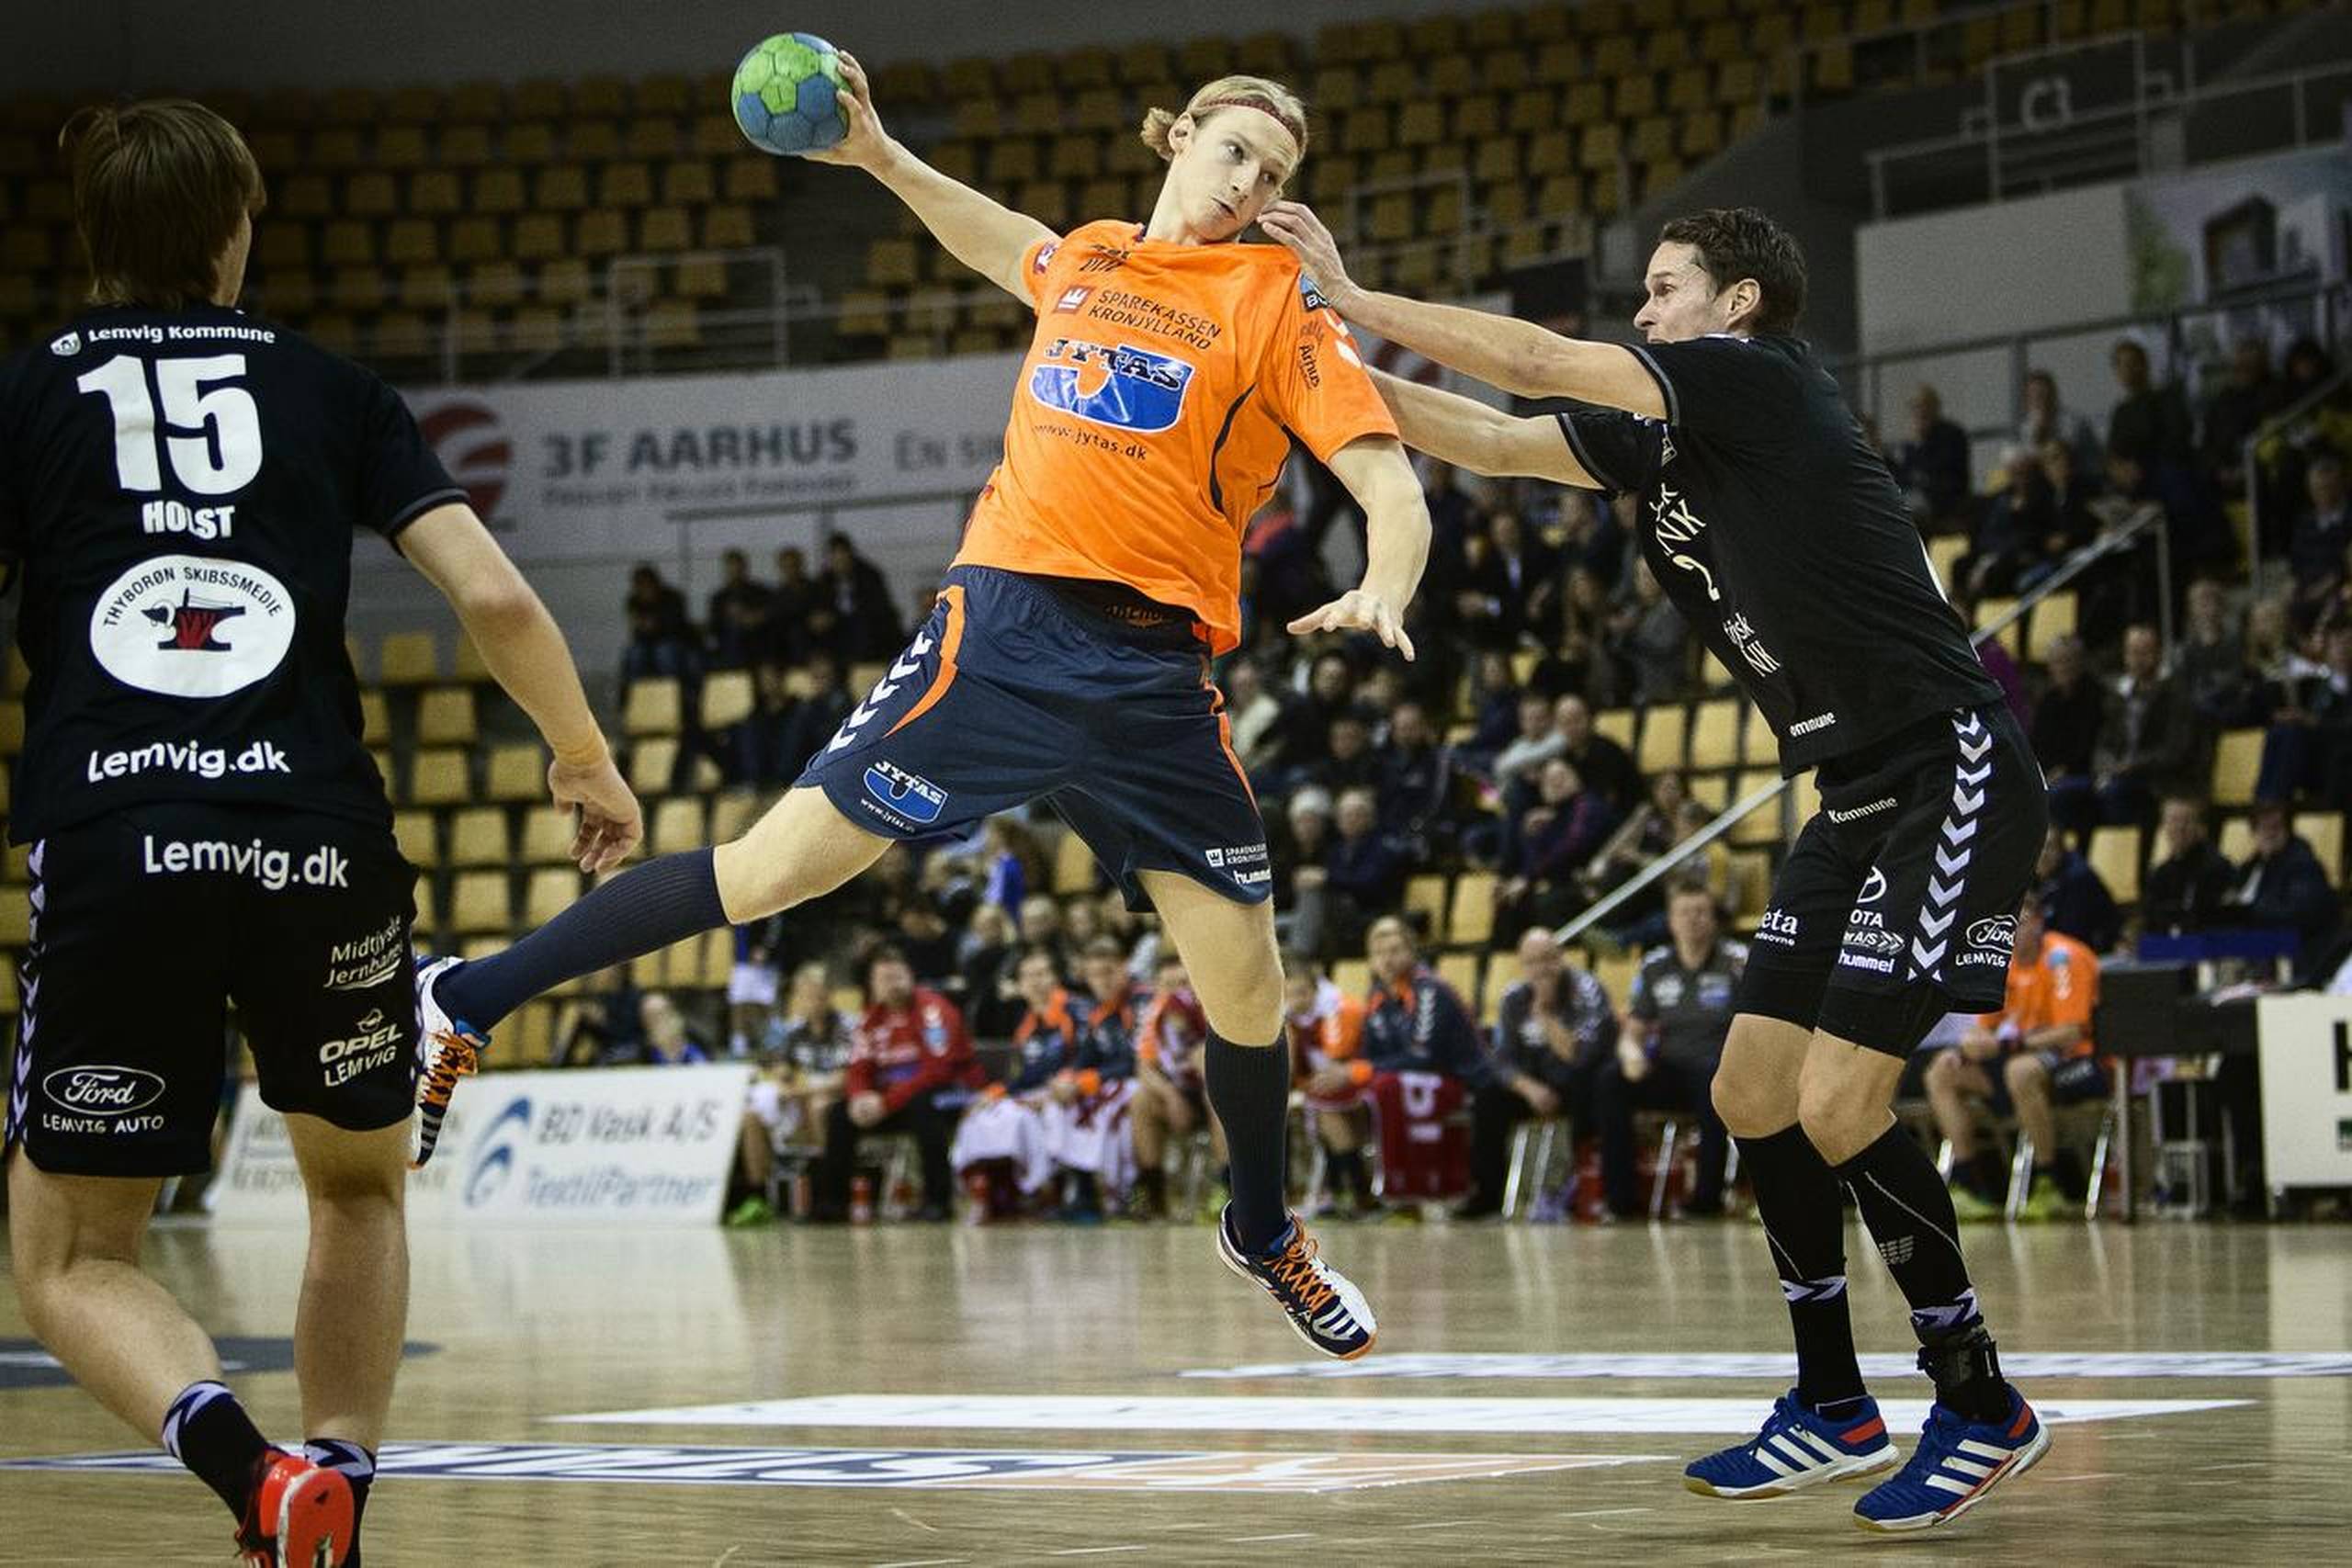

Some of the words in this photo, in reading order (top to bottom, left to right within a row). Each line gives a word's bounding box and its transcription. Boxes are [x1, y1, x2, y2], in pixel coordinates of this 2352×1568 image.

[88, 325, 164, 344] Lemvig
[168, 326, 276, 344] Kommune
[1088, 304, 1212, 350] KRONJYLLAND
[1098, 289, 1222, 338] SPAREKASSEN
[1045, 338, 1183, 389] JYTAS
[76, 355, 263, 495] 15
[1033, 424, 1148, 460] www.jytas.dk
[544, 432, 610, 479] 3F
[626, 418, 859, 474] AARHUS
[103, 567, 176, 627] THYBORØN
[183, 566, 283, 617] SKIBSSMEDIE
[88, 739, 292, 783] Lemvig.dk
[875, 761, 944, 806] JYTAS
[1827, 796, 1898, 824] Kommune
[143, 835, 349, 890] Lemvig.dk
[1849, 908, 1883, 928] OTA
[1838, 948, 1895, 974] hummel
[319, 1023, 403, 1064] OPEL
[324, 1045, 397, 1087] LEMVIG
[64, 1072, 137, 1104] Ford
[42, 1113, 107, 1134] LEMVIG
[114, 1115, 164, 1134] AUTO
